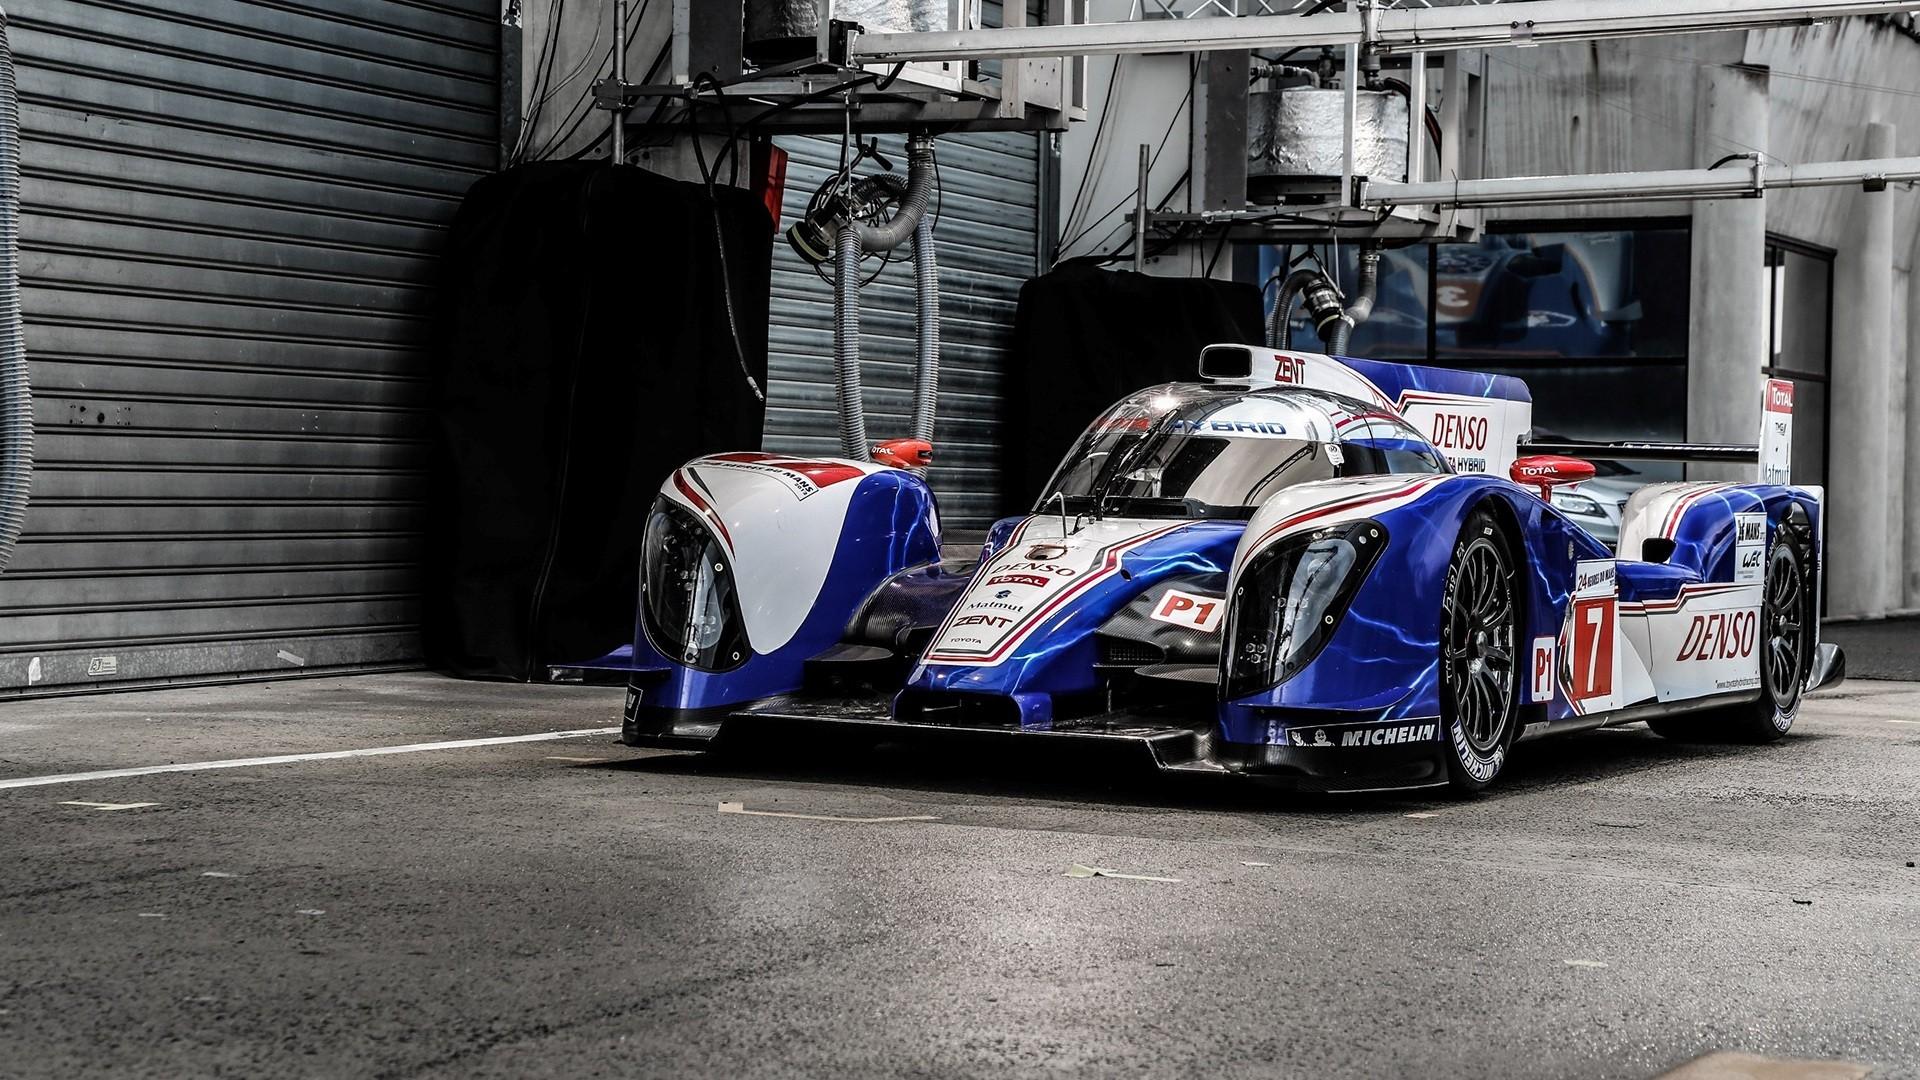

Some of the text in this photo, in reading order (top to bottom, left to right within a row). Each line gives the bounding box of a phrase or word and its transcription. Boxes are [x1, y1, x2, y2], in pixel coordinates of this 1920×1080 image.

[1274, 355, 1305, 384] ZENT
[1771, 387, 1793, 407] TOTAL
[1432, 413, 1488, 451] DENSO
[872, 446, 894, 455] OTAL
[1457, 456, 1486, 473] HYBRID
[1520, 466, 1559, 476] TOTAL
[783, 472, 814, 492] MANS
[1743, 550, 1762, 568] WEC
[991, 562, 1076, 577] DENSO
[993, 576, 1044, 587] TOTAL
[1577, 572, 1587, 592] 24
[966, 601, 1024, 613] Matmut
[1160, 595, 1216, 625] P1
[952, 615, 1013, 628] ZENT
[1676, 611, 1756, 661] DENSO
[1587, 606, 1604, 692] 7
[1535, 648, 1552, 693] P1
[1341, 724, 1436, 747] MICHELIN
[1453, 724, 1494, 780] MICHELIN
